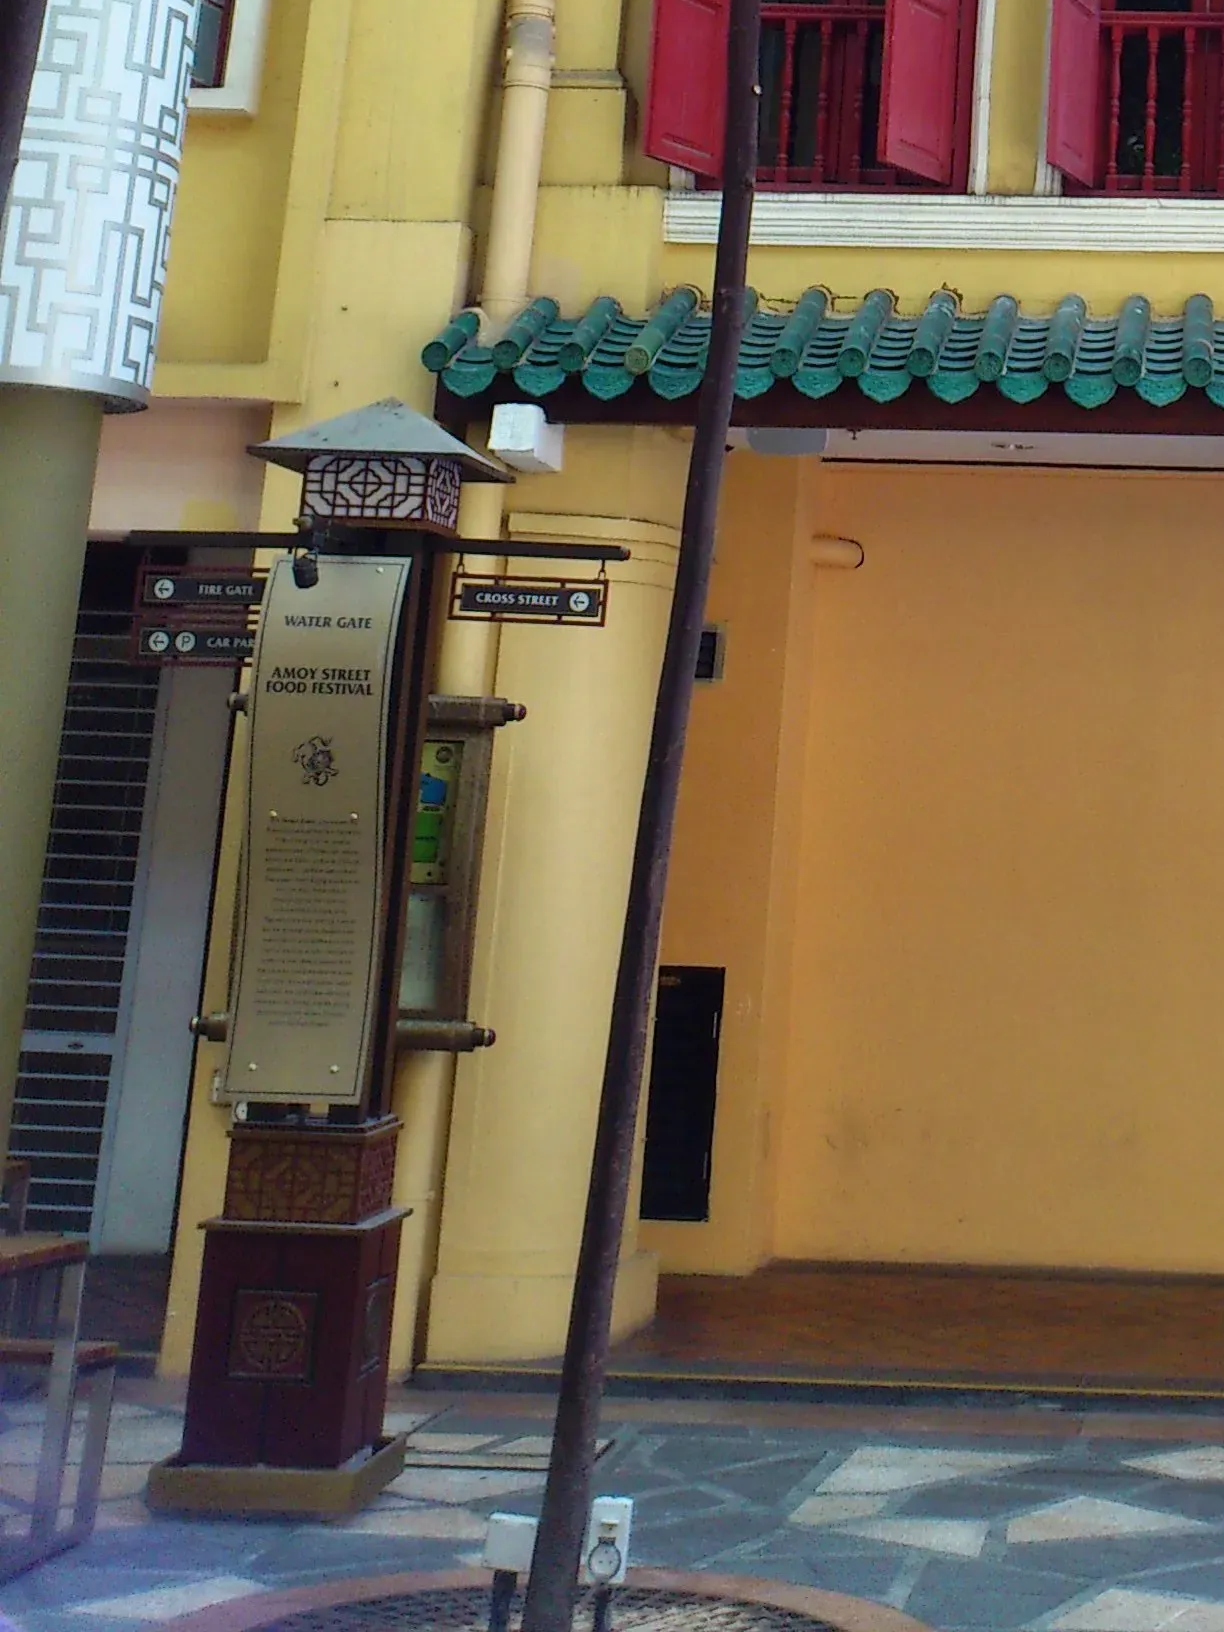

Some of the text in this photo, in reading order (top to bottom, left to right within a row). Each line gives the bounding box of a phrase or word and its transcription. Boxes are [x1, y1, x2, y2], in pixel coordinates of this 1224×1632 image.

[199, 584, 253, 596] FIRE GATE
[475, 591, 559, 606] CROSS STREET
[284, 615, 372, 629] WATER GATE
[206, 637, 231, 648] CAR
[233, 637, 254, 648] PAR
[272, 667, 371, 681] AMOY STREET
[266, 681, 374, 696] FOOD FESTIVAL
